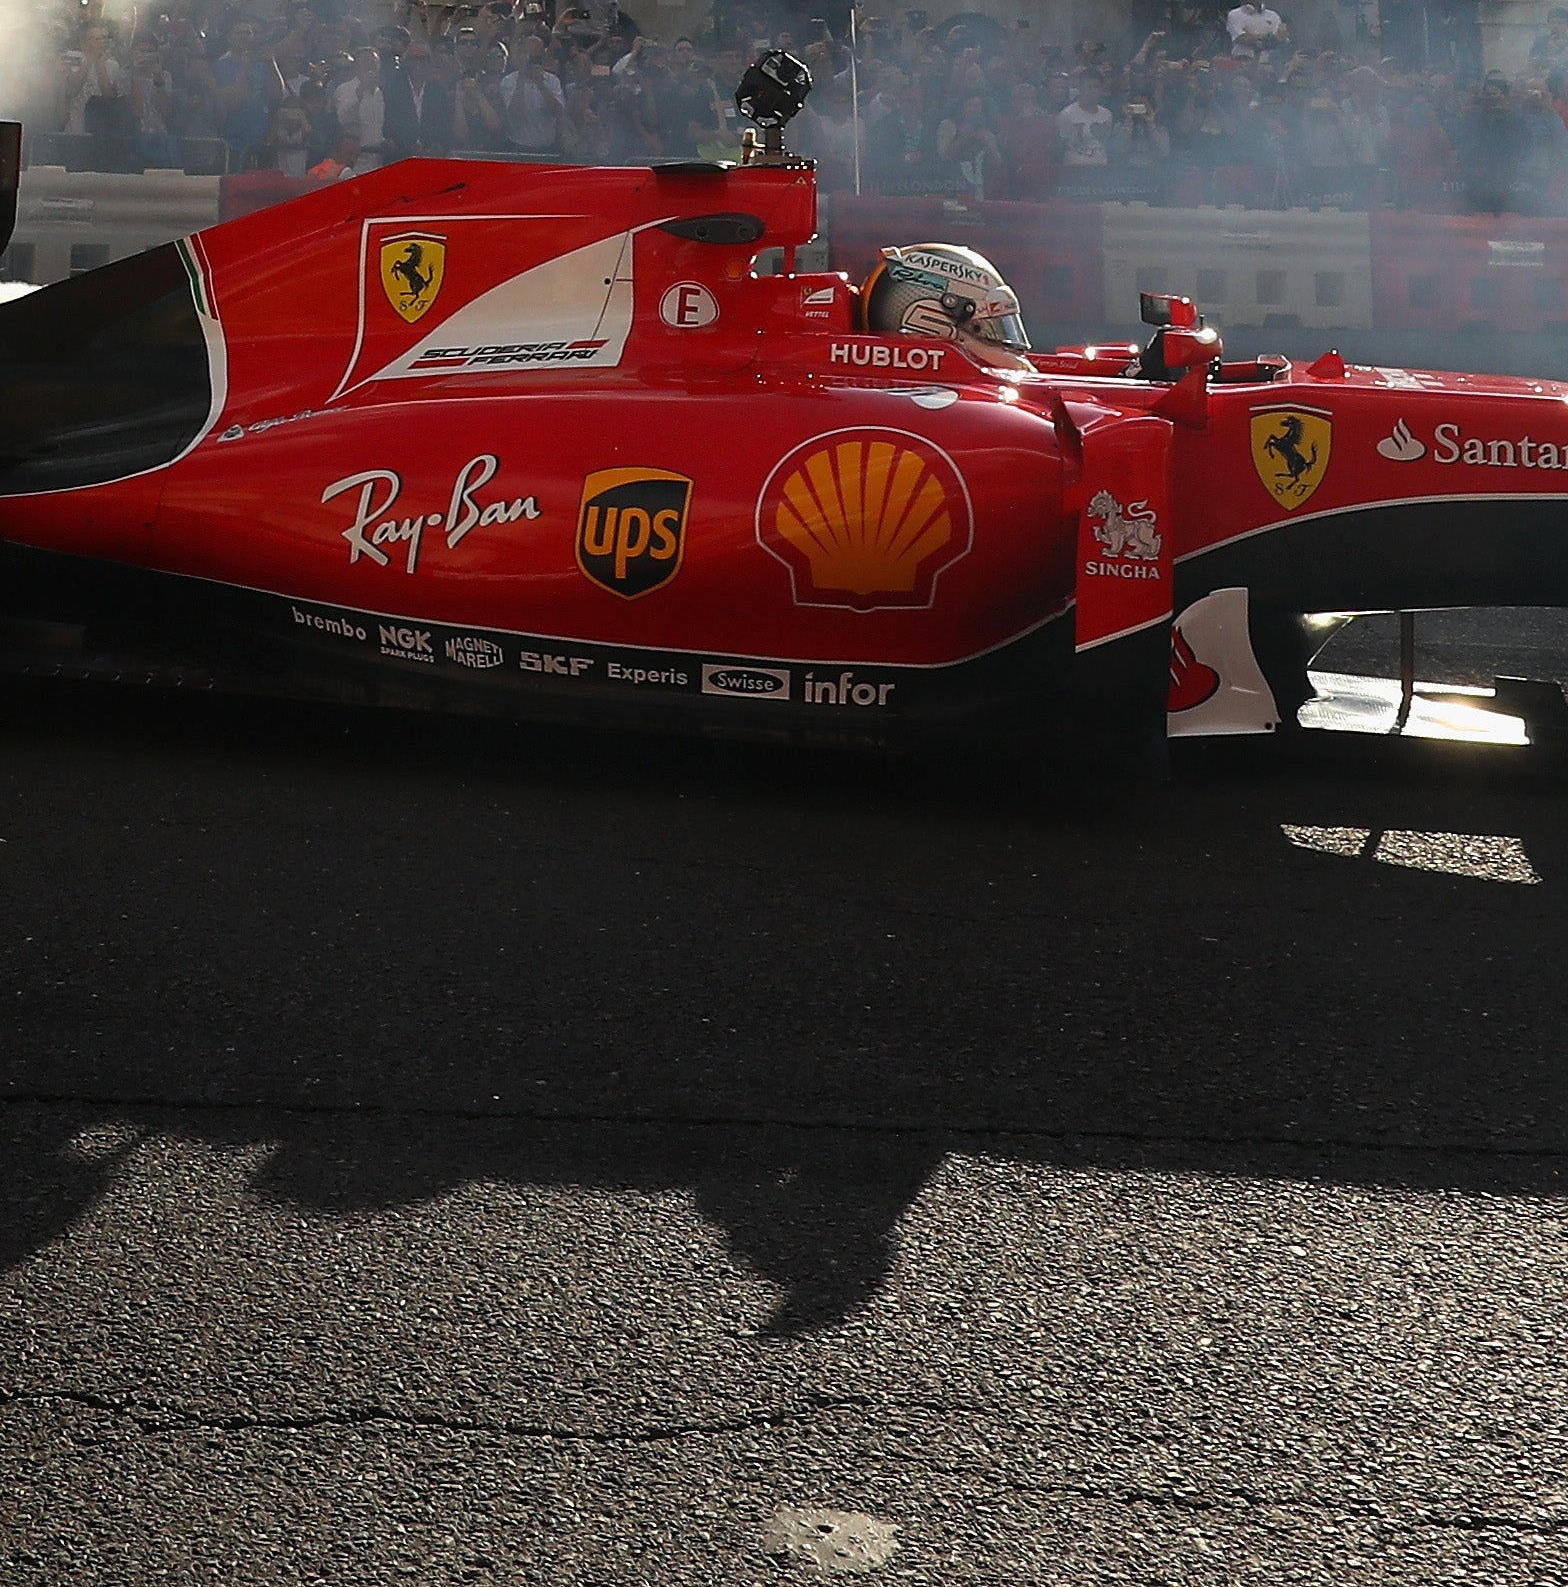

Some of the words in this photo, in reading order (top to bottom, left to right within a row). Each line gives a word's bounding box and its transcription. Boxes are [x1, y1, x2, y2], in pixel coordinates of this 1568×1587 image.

[904, 252, 983, 283] KASPERSKY
[677, 287, 701, 324] E
[805, 310, 830, 319] VETTEL
[420, 342, 566, 360] SCUDERIA
[467, 348, 598, 366] FERRARI
[830, 343, 946, 371] HUBLOT
[583, 505, 680, 580] ups
[1085, 562, 1161, 580] SINGHA
[292, 606, 367, 641] brembo
[379, 624, 434, 654] NGK
[380, 646, 407, 660] SPARK
[407, 651, 435, 663] PLUGS
[519, 650, 595, 676] SKF
[607, 662, 689, 686] Experis
[716, 671, 775, 691] Swisse
[803, 671, 896, 706] infor
